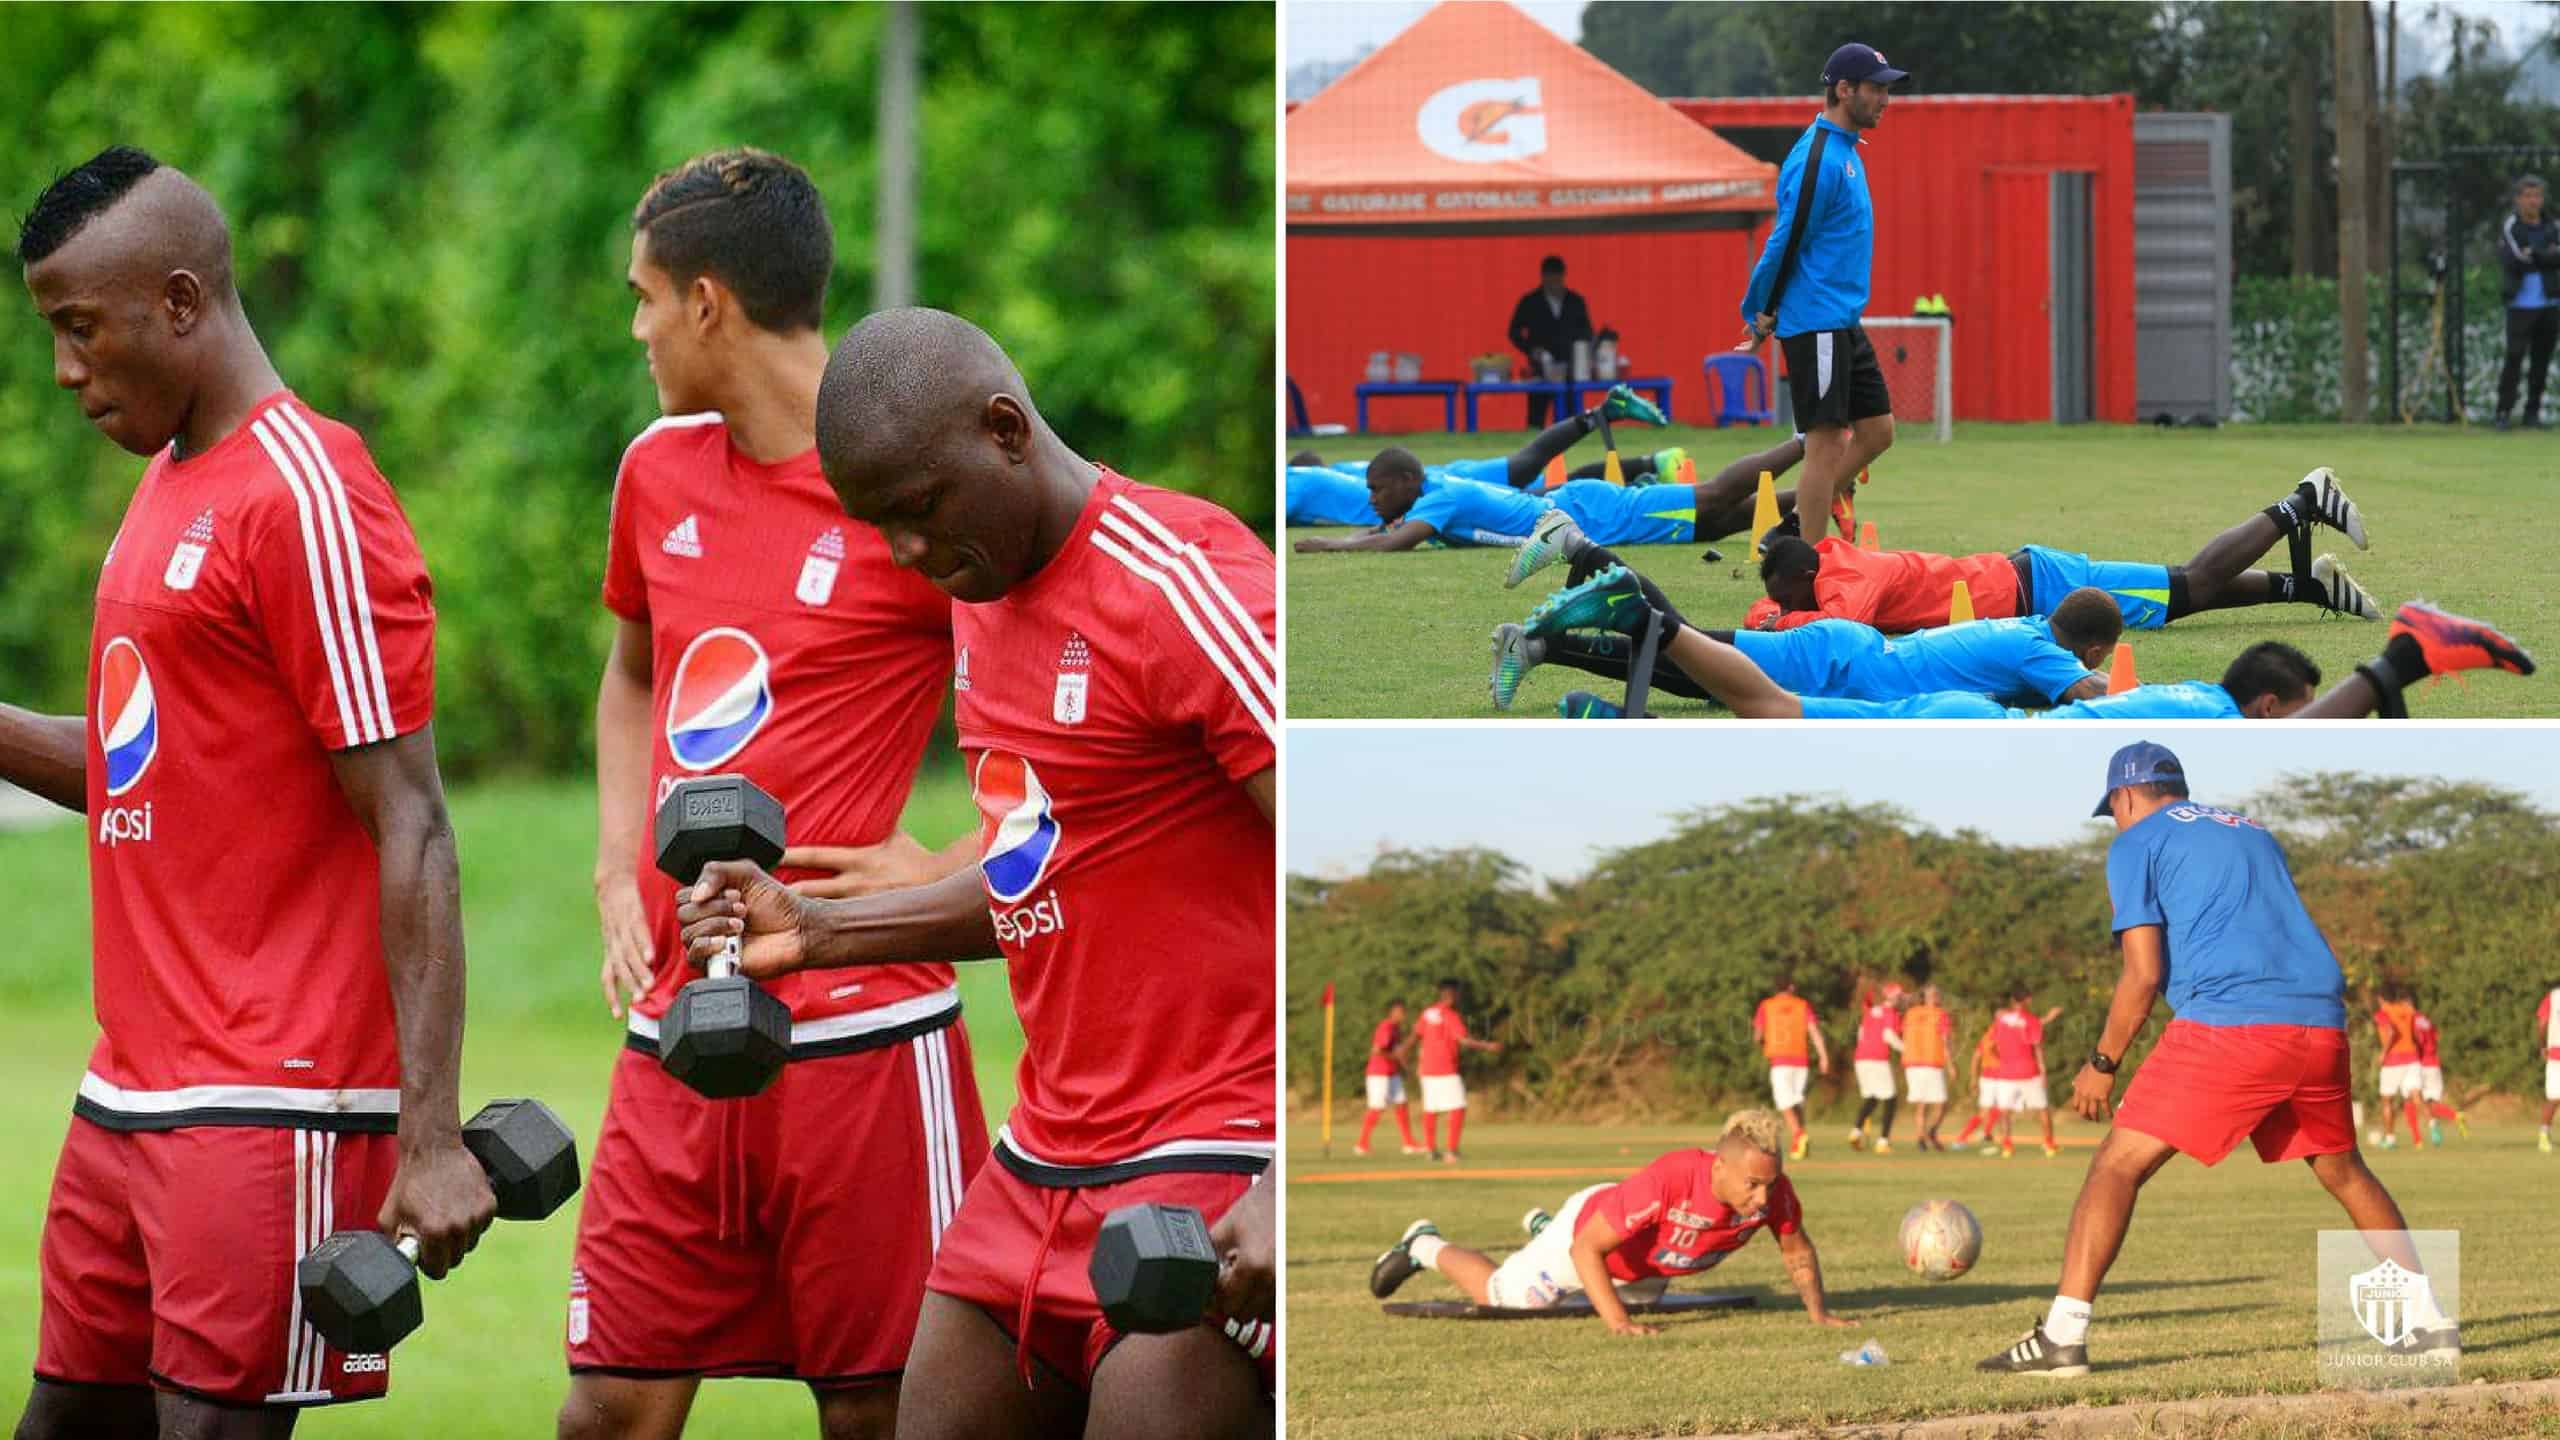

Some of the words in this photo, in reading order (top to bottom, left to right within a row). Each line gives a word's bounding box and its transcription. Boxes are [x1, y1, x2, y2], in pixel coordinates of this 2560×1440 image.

[1417, 76, 1547, 162] G
[100, 800, 152, 848] psi
[1669, 1226, 1699, 1249] 10
